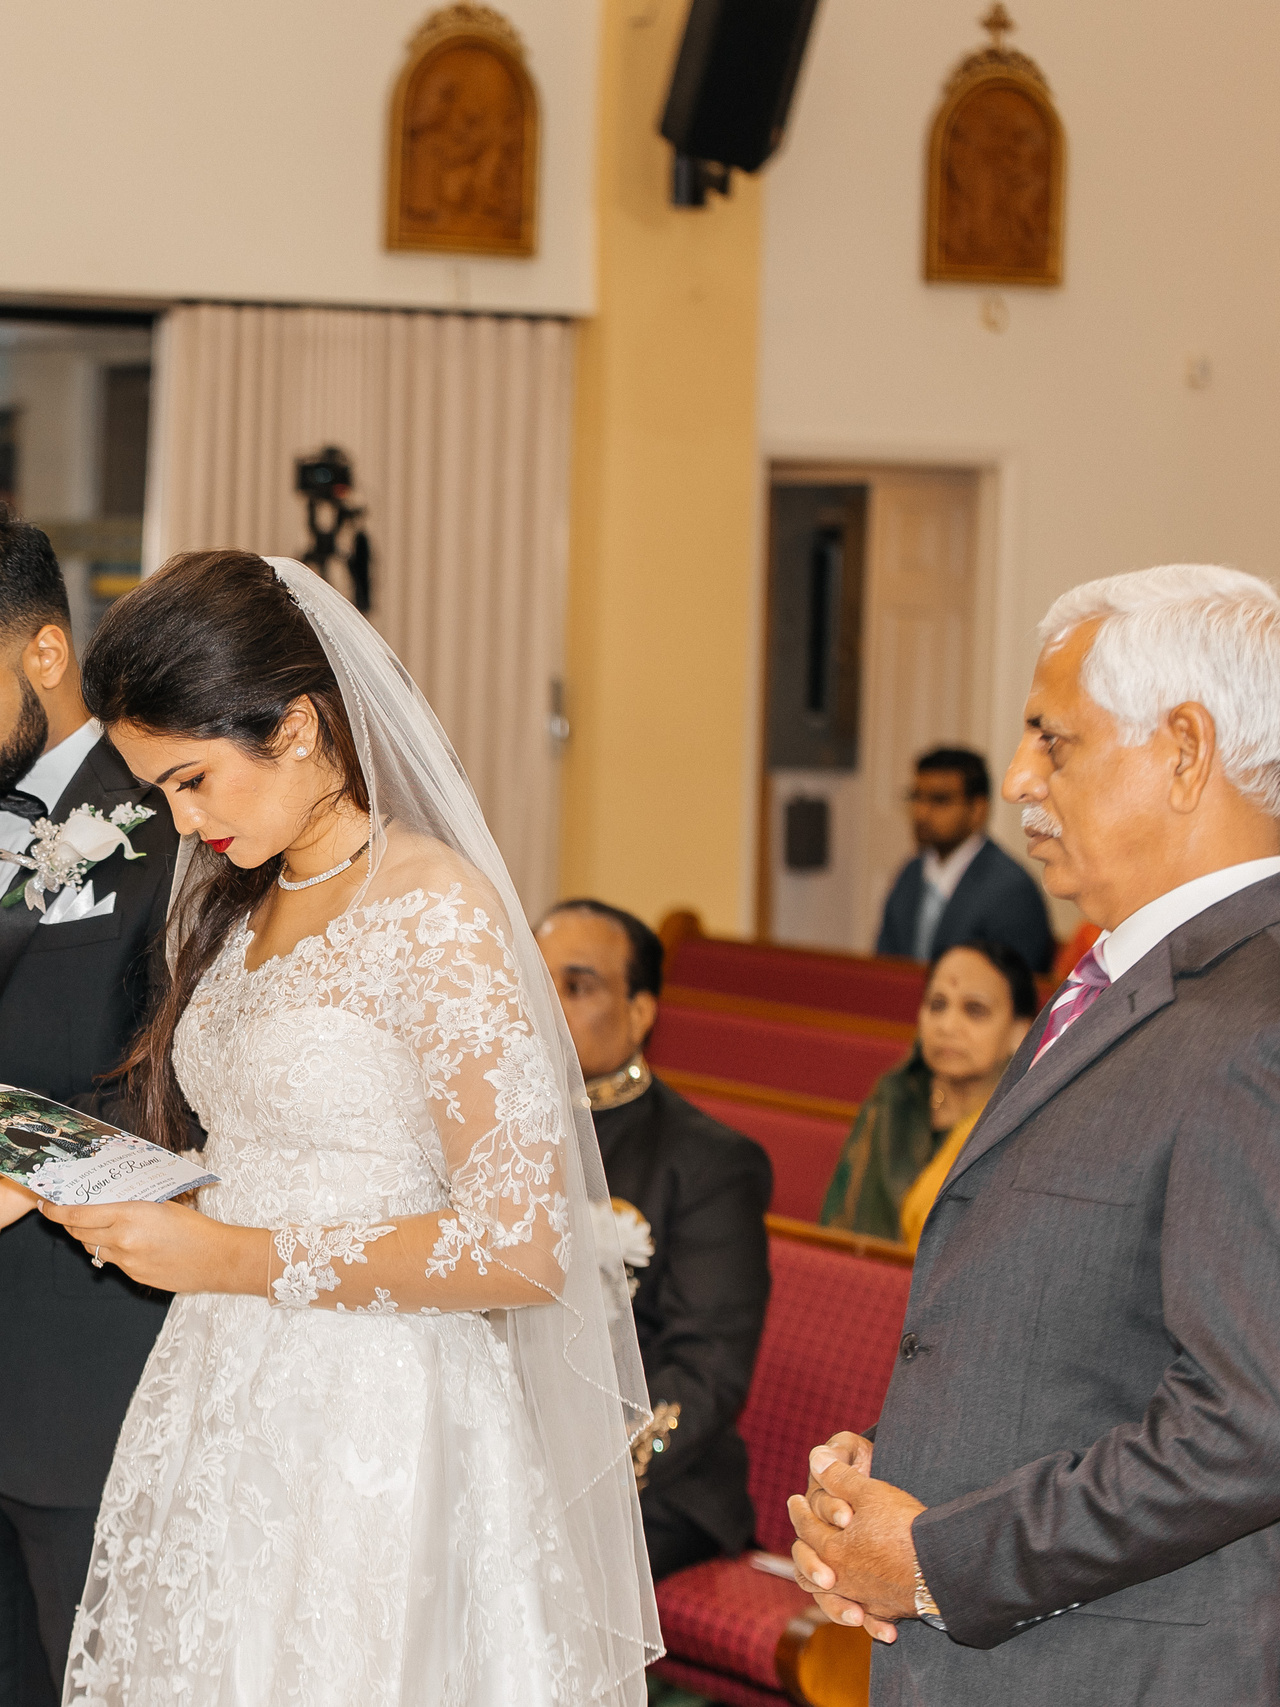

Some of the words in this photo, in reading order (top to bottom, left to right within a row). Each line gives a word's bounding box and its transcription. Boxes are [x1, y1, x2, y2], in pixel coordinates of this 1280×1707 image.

[65, 1177, 79, 1190] THE
[79, 1167, 98, 1180] HOLY
[98, 1152, 137, 1170] MATRIMONY
[74, 1179, 112, 1205] Kevin
[108, 1168, 122, 1180] &
[115, 1185, 136, 1199] JUNE
